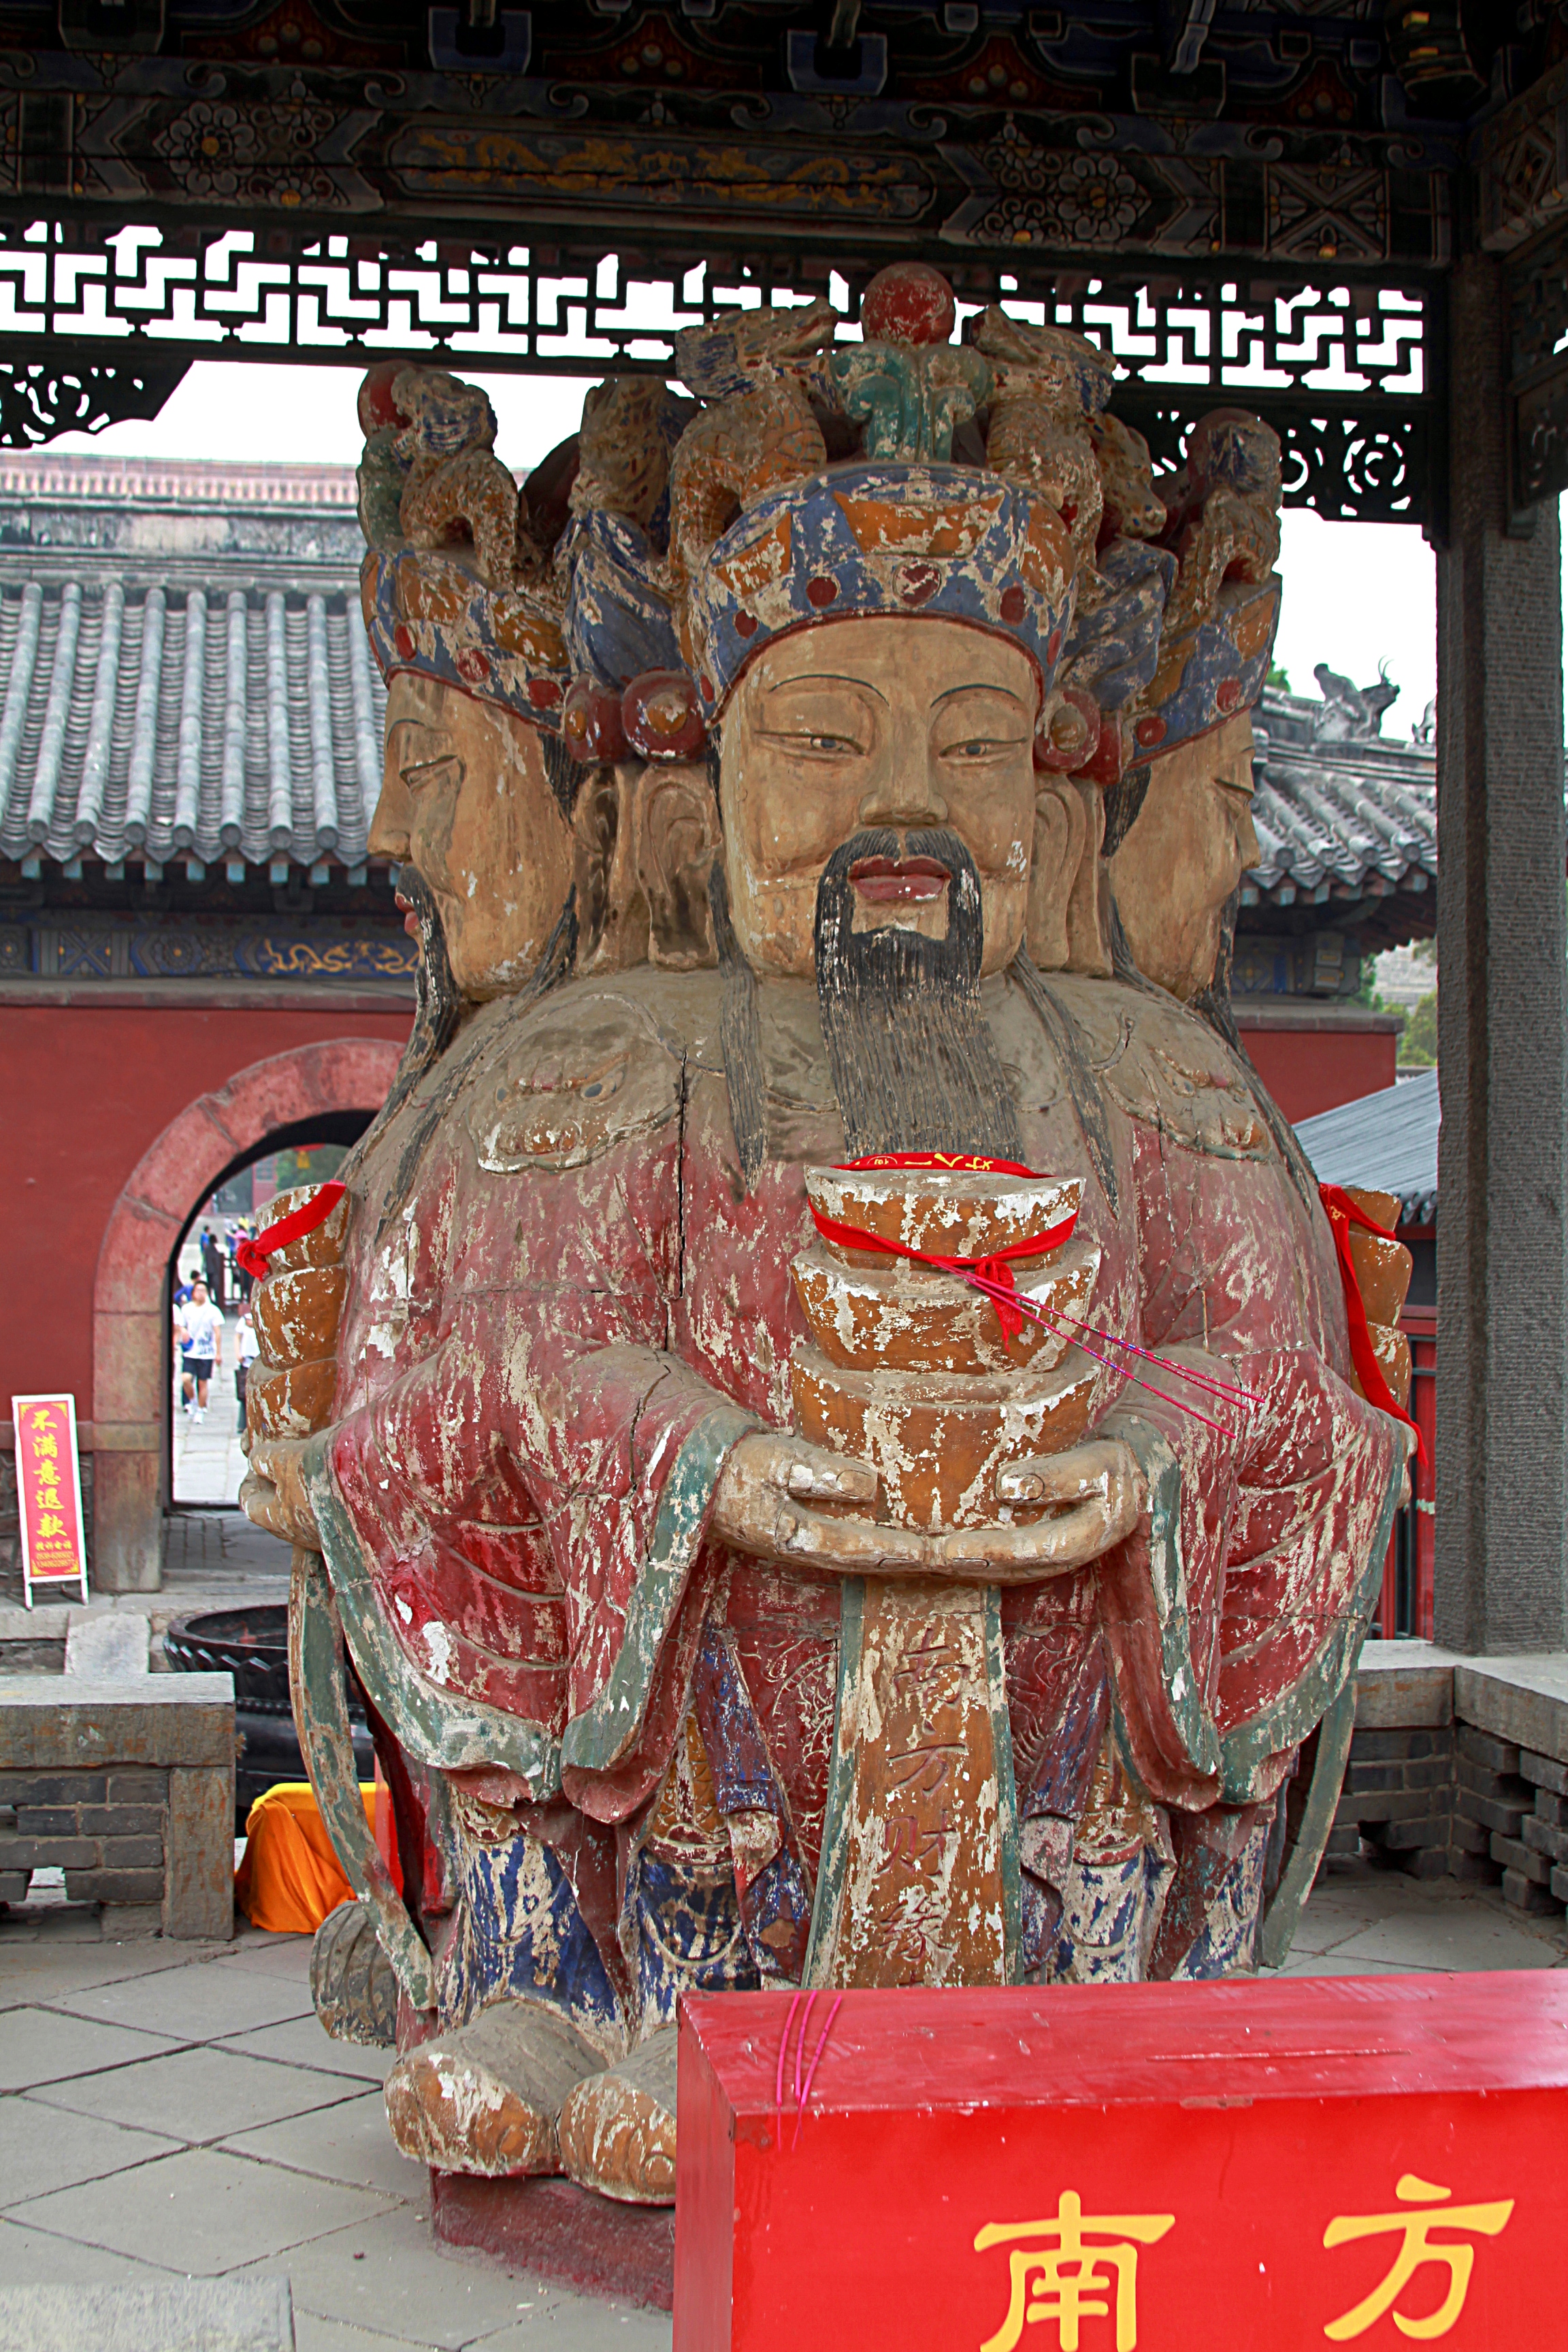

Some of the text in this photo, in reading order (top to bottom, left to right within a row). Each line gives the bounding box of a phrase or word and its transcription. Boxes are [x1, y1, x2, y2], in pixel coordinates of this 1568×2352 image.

[31, 1409, 67, 1539] 不满意退款
[974, 2174, 1514, 2352] 南方
